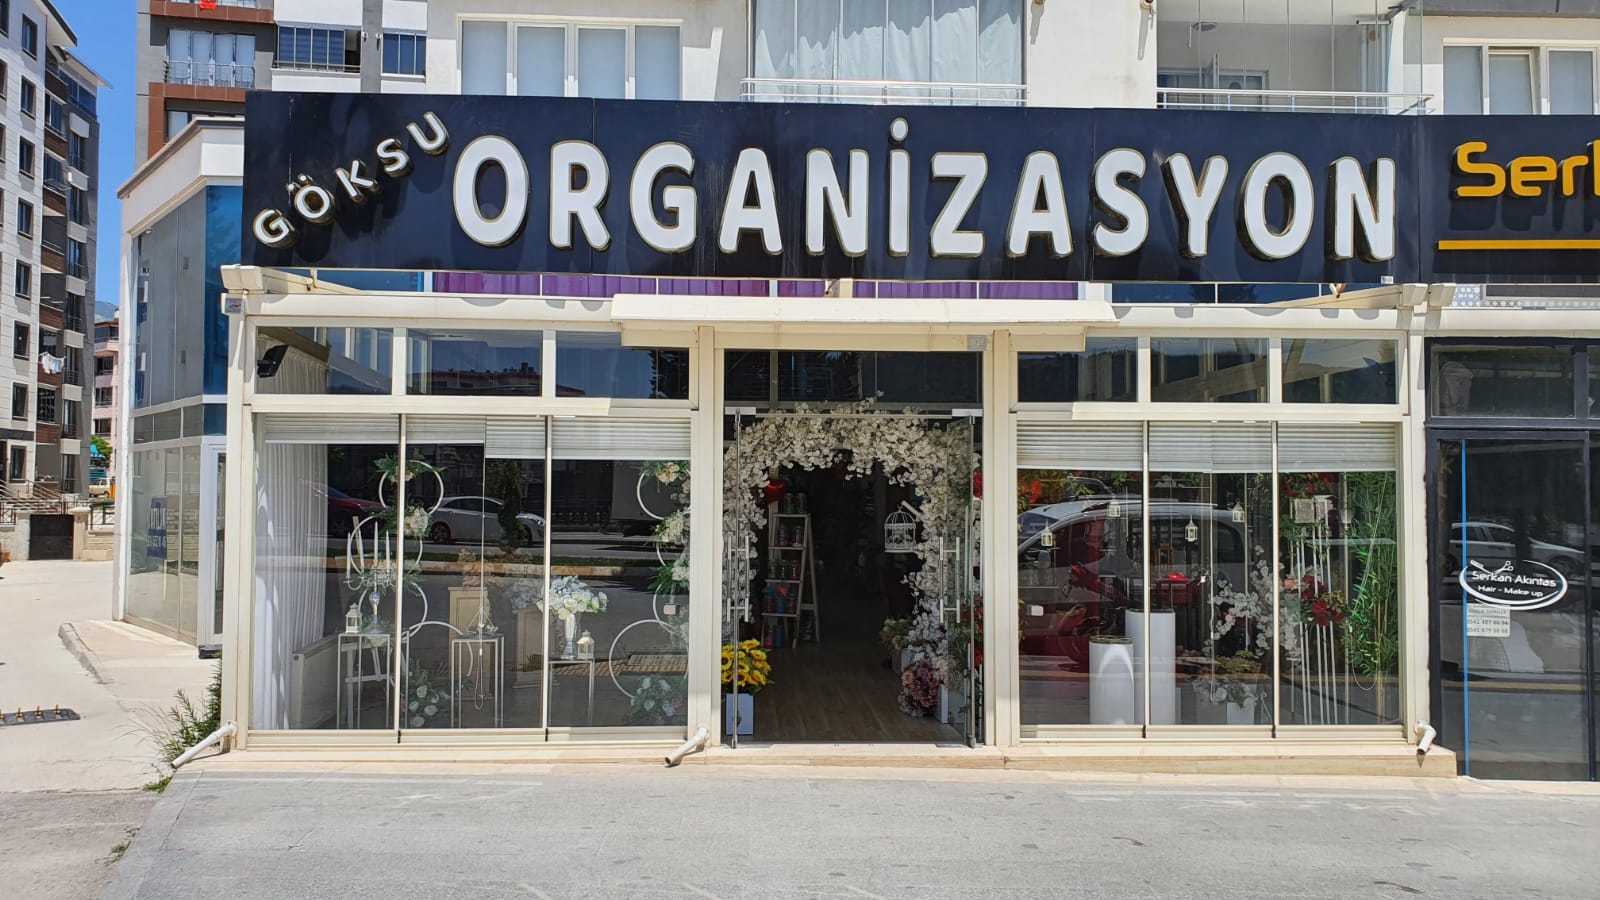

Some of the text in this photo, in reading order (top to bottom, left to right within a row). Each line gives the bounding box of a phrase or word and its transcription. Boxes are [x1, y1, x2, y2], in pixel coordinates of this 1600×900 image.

[253, 111, 449, 247] GÖKSU
[452, 117, 1397, 261] ORGANİZASYON
[1456, 139, 1600, 198] Ser
[1472, 570, 1512, 583] Serkan
[1504, 587, 1530, 595] Make
